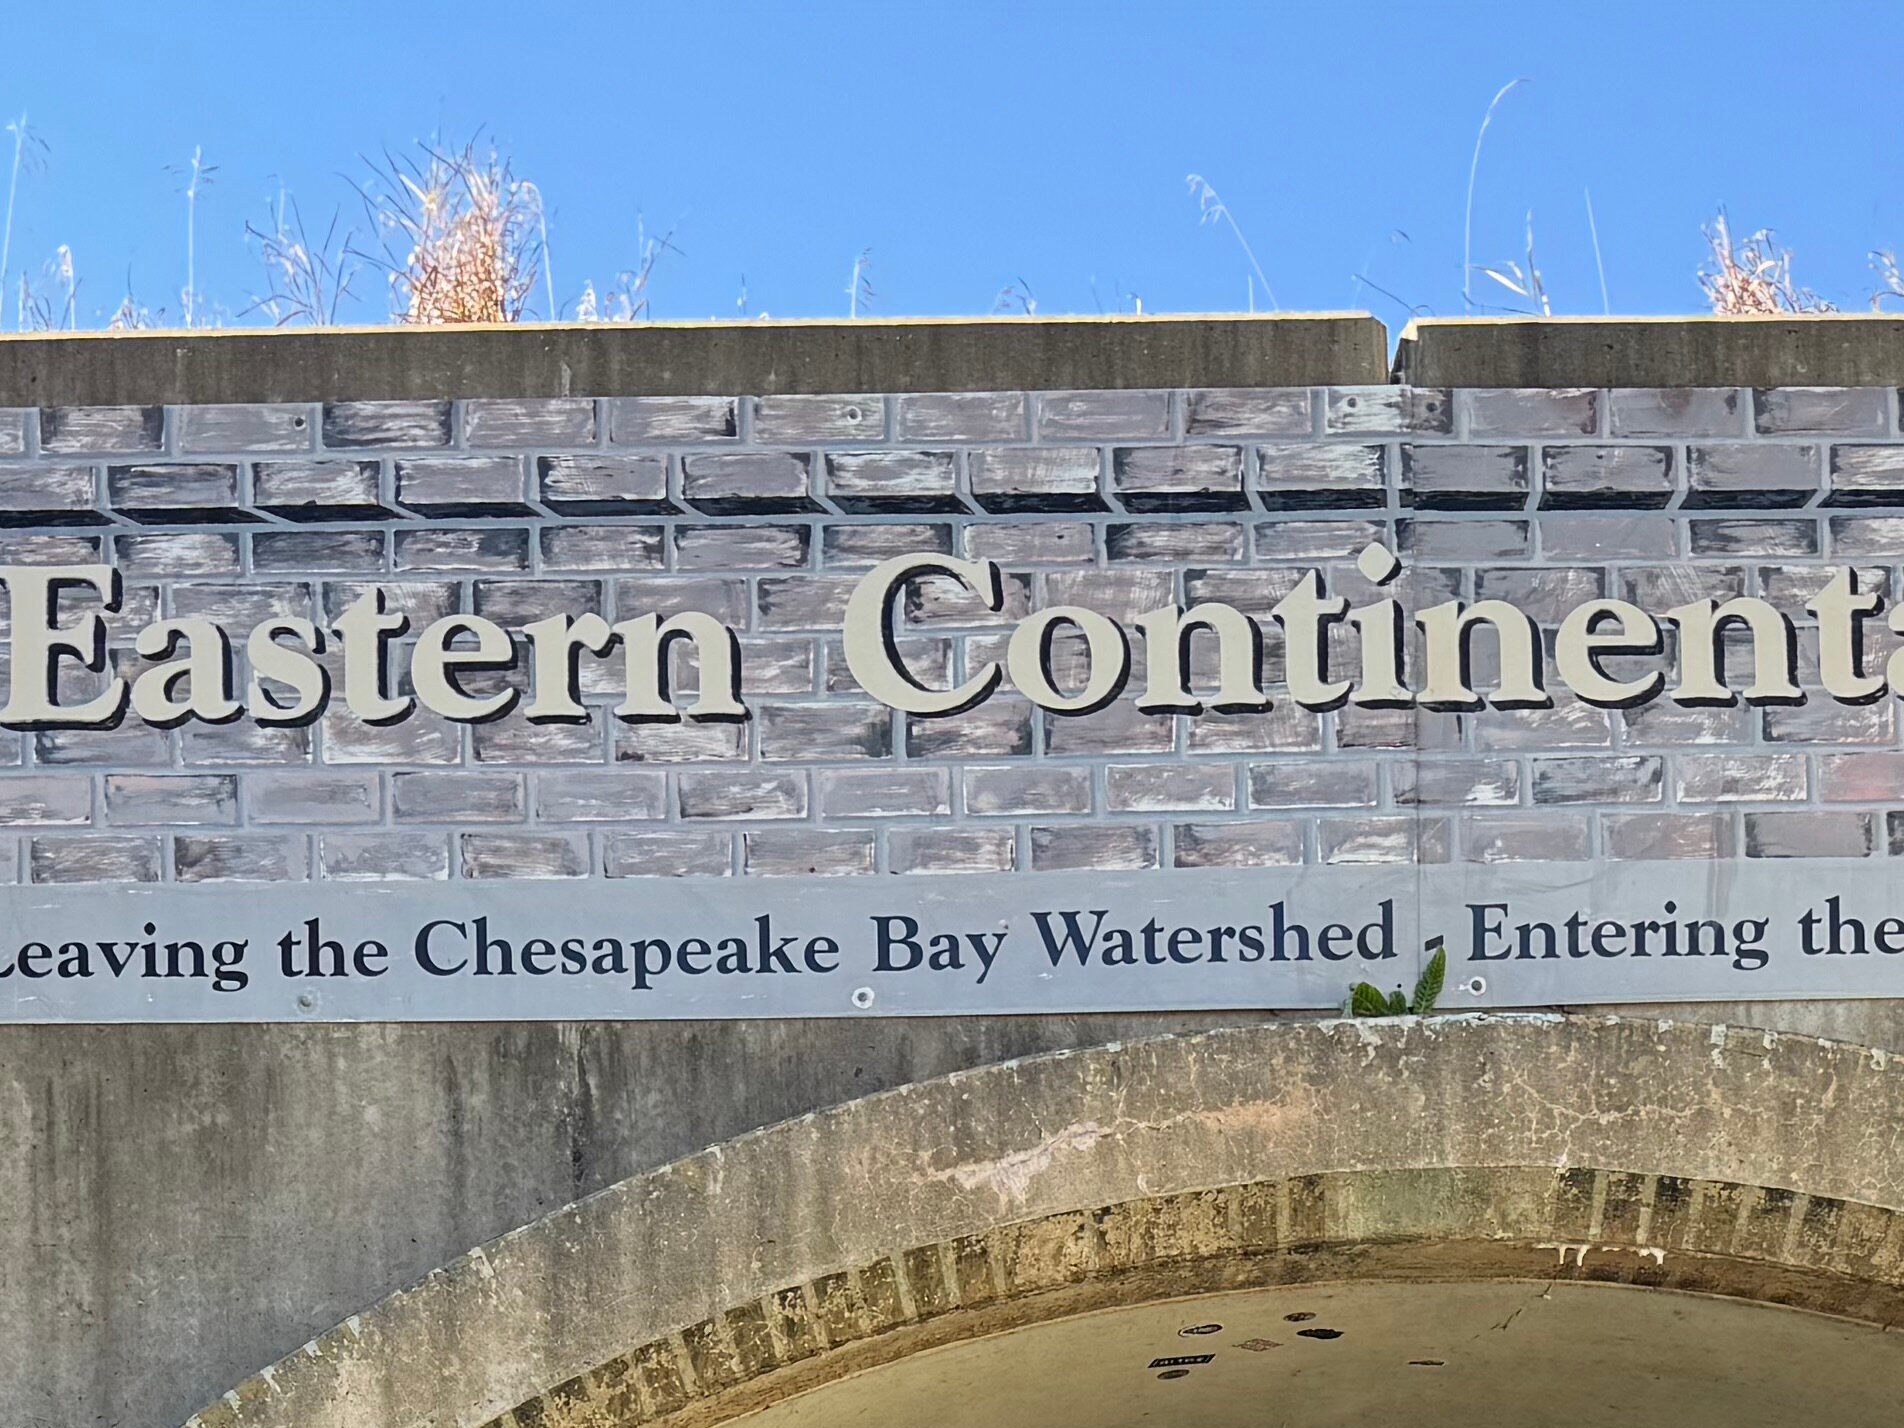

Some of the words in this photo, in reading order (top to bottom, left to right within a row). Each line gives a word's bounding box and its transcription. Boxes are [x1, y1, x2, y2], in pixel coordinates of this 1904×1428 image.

[277, 916, 389, 978] the
[413, 912, 839, 990] Chesapeake
[869, 912, 1009, 985] Bay
[1029, 898, 1399, 967] Watershed
[1465, 902, 1770, 971] Entering
